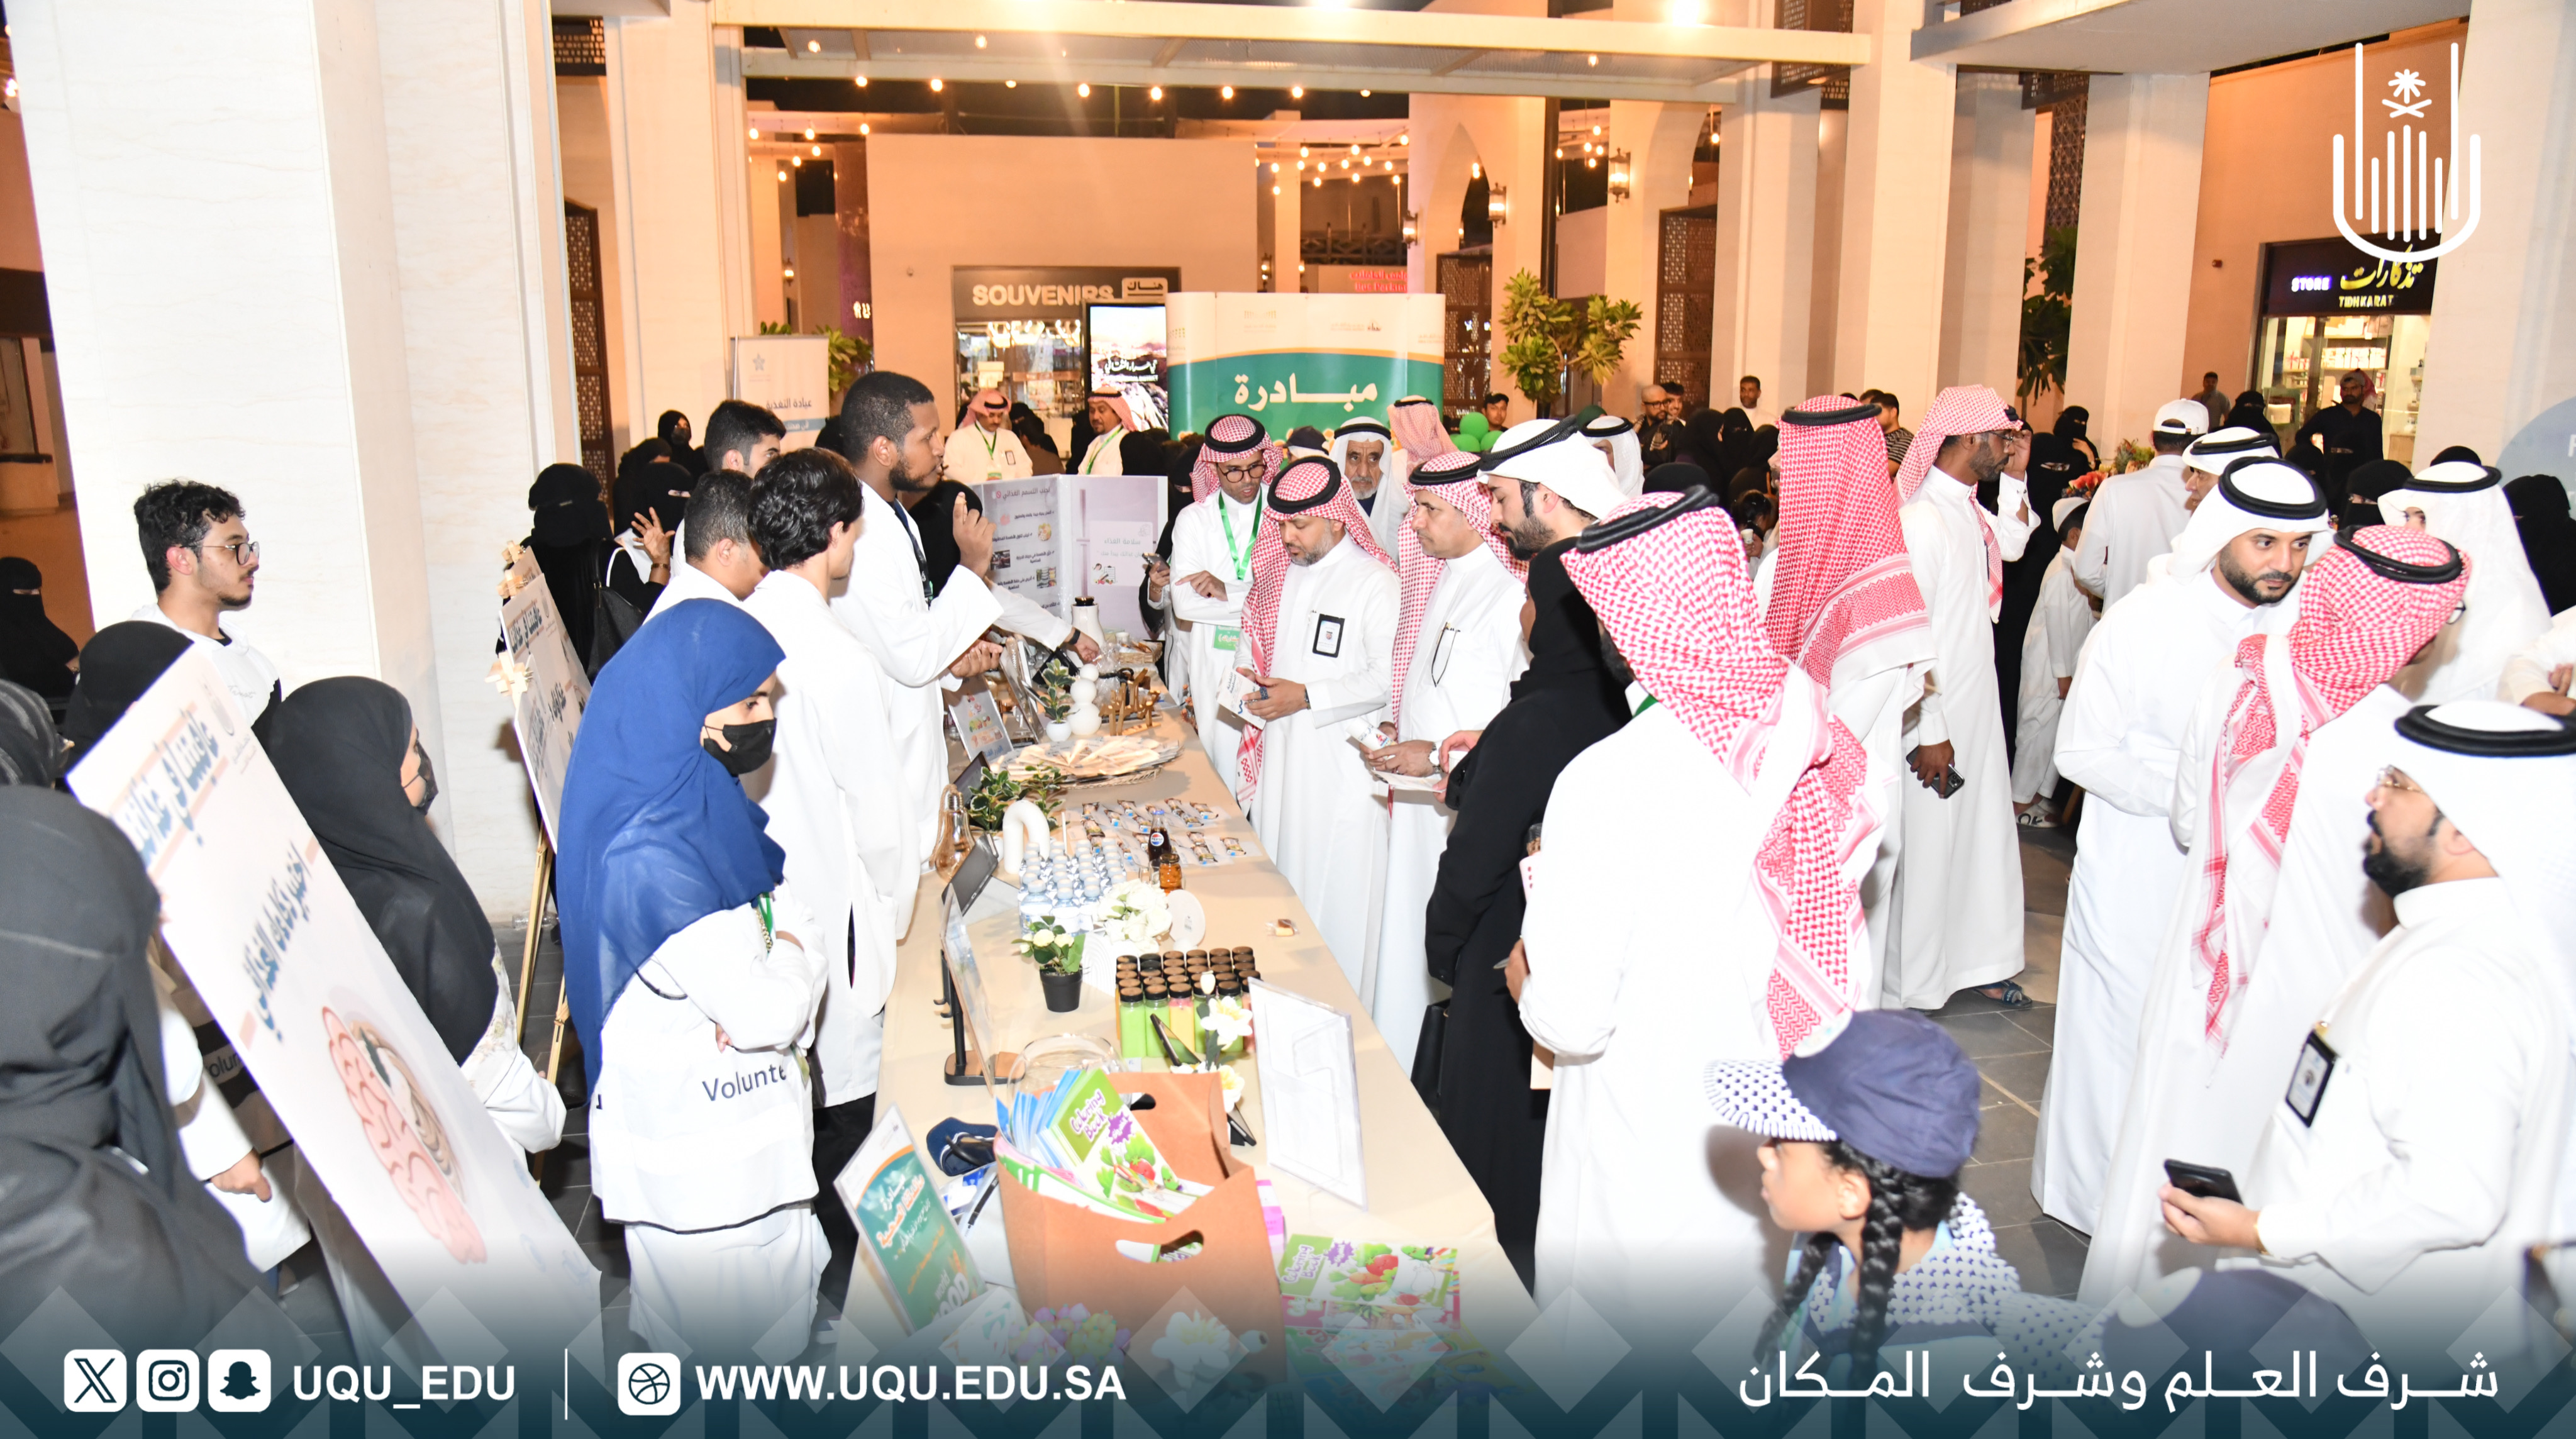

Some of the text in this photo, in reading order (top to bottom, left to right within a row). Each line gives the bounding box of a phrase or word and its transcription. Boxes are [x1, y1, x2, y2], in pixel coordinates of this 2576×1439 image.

[972, 284, 1115, 306] SOUVENIRS
[2291, 277, 2330, 292] STORE
[2339, 295, 2394, 308] TIDHKARAT
[793, 397, 812, 409] عيادة
[1234, 372, 1378, 412] مبادرة
[164, 707, 219, 793] عافيتنا
[702, 1064, 787, 1101] Volunte
[1070, 1089, 1106, 1135] Coloring
[1083, 1108, 1109, 1142] Book
[880, 1174, 906, 1212] مبادرة
[1281, 1244, 1313, 1284] Coloring
[1301, 1252, 1322, 1280] Book
[934, 1270, 950, 1300] world
[936, 1272, 970, 1319] OOD
